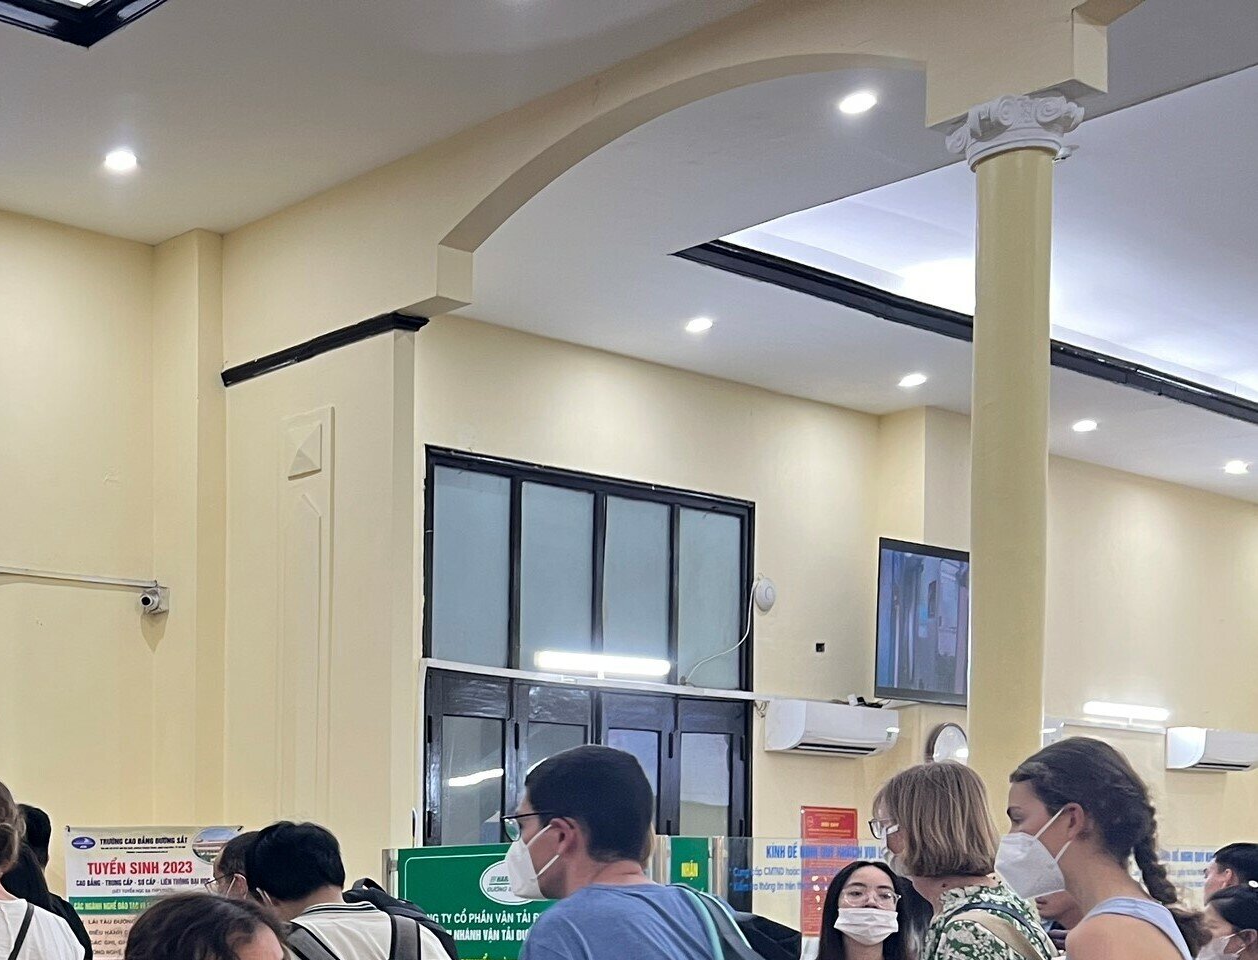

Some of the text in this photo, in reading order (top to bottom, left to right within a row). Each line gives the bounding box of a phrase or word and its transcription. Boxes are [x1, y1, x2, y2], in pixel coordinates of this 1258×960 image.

[766, 842, 785, 859] KÍNH
[87, 856, 193, 875] TUYỂN SINH 2023
[426, 912, 439, 924] NG
[441, 912, 452, 924] TY
[453, 907, 467, 924] CỔ
[495, 910, 513, 926] VẬN
[516, 908, 530, 924] TẢI
[453, 926, 514, 944] NHÁNH VẬN TẢI
